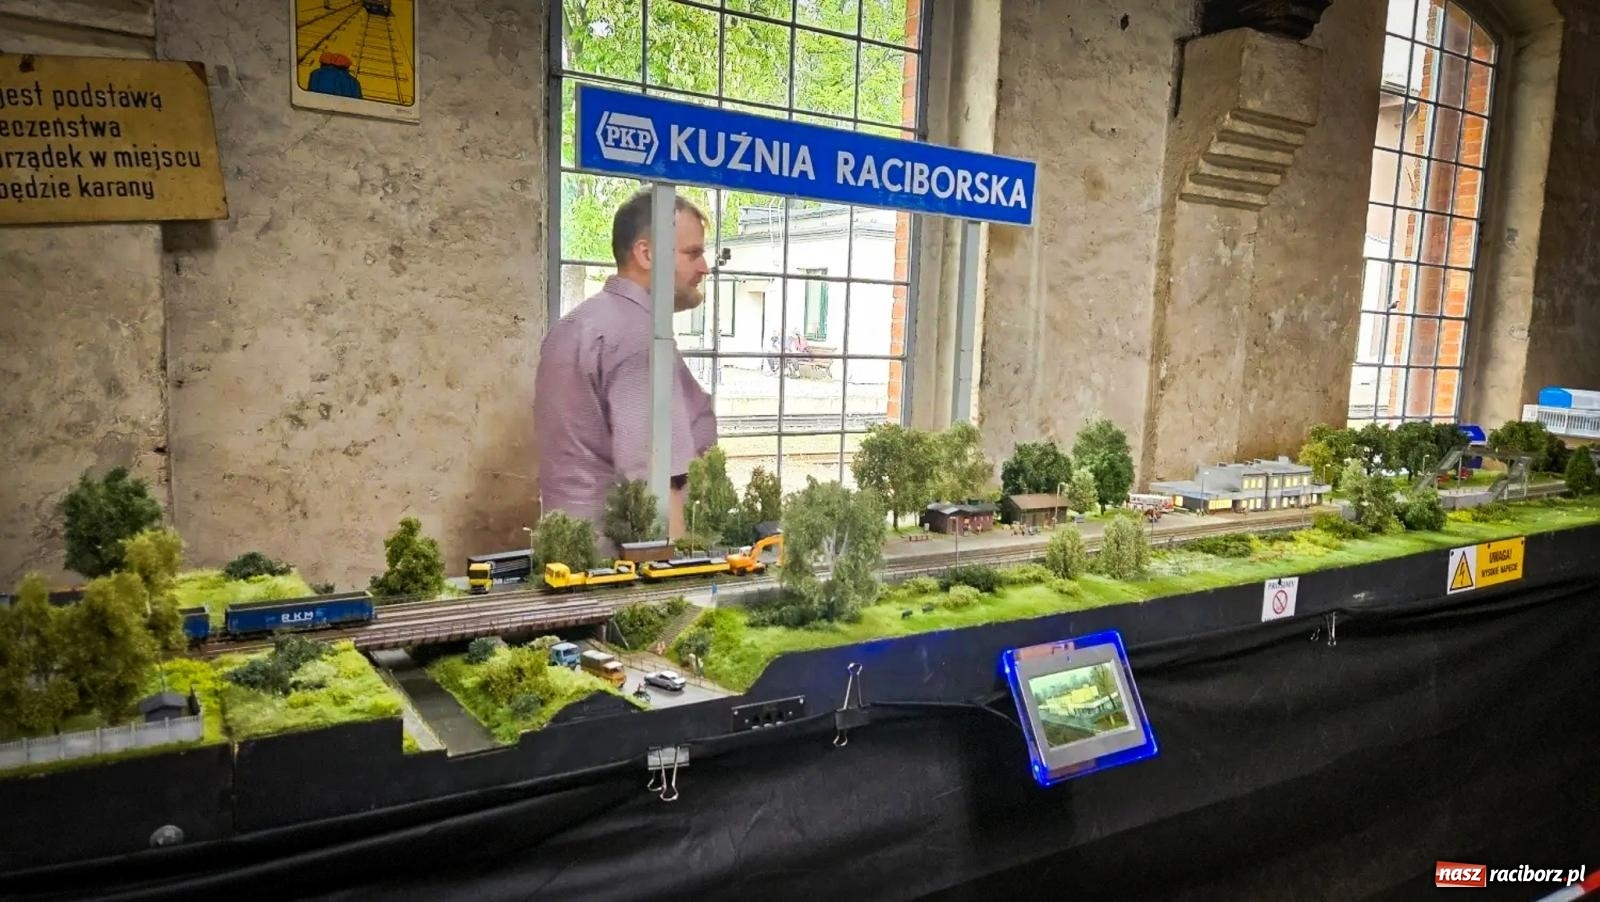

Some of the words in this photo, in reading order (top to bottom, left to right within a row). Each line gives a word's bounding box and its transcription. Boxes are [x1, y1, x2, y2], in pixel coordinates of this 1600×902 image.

[53, 82, 163, 112] podstawą
[605, 125, 651, 150] PKP
[0, 143, 83, 171] rządek
[90, 151, 108, 168] w
[115, 144, 200, 170] miejscu
[670, 124, 816, 180] KUŹNIA
[836, 150, 1027, 209] RACIBORSKA
[78, 175, 154, 200] karany
